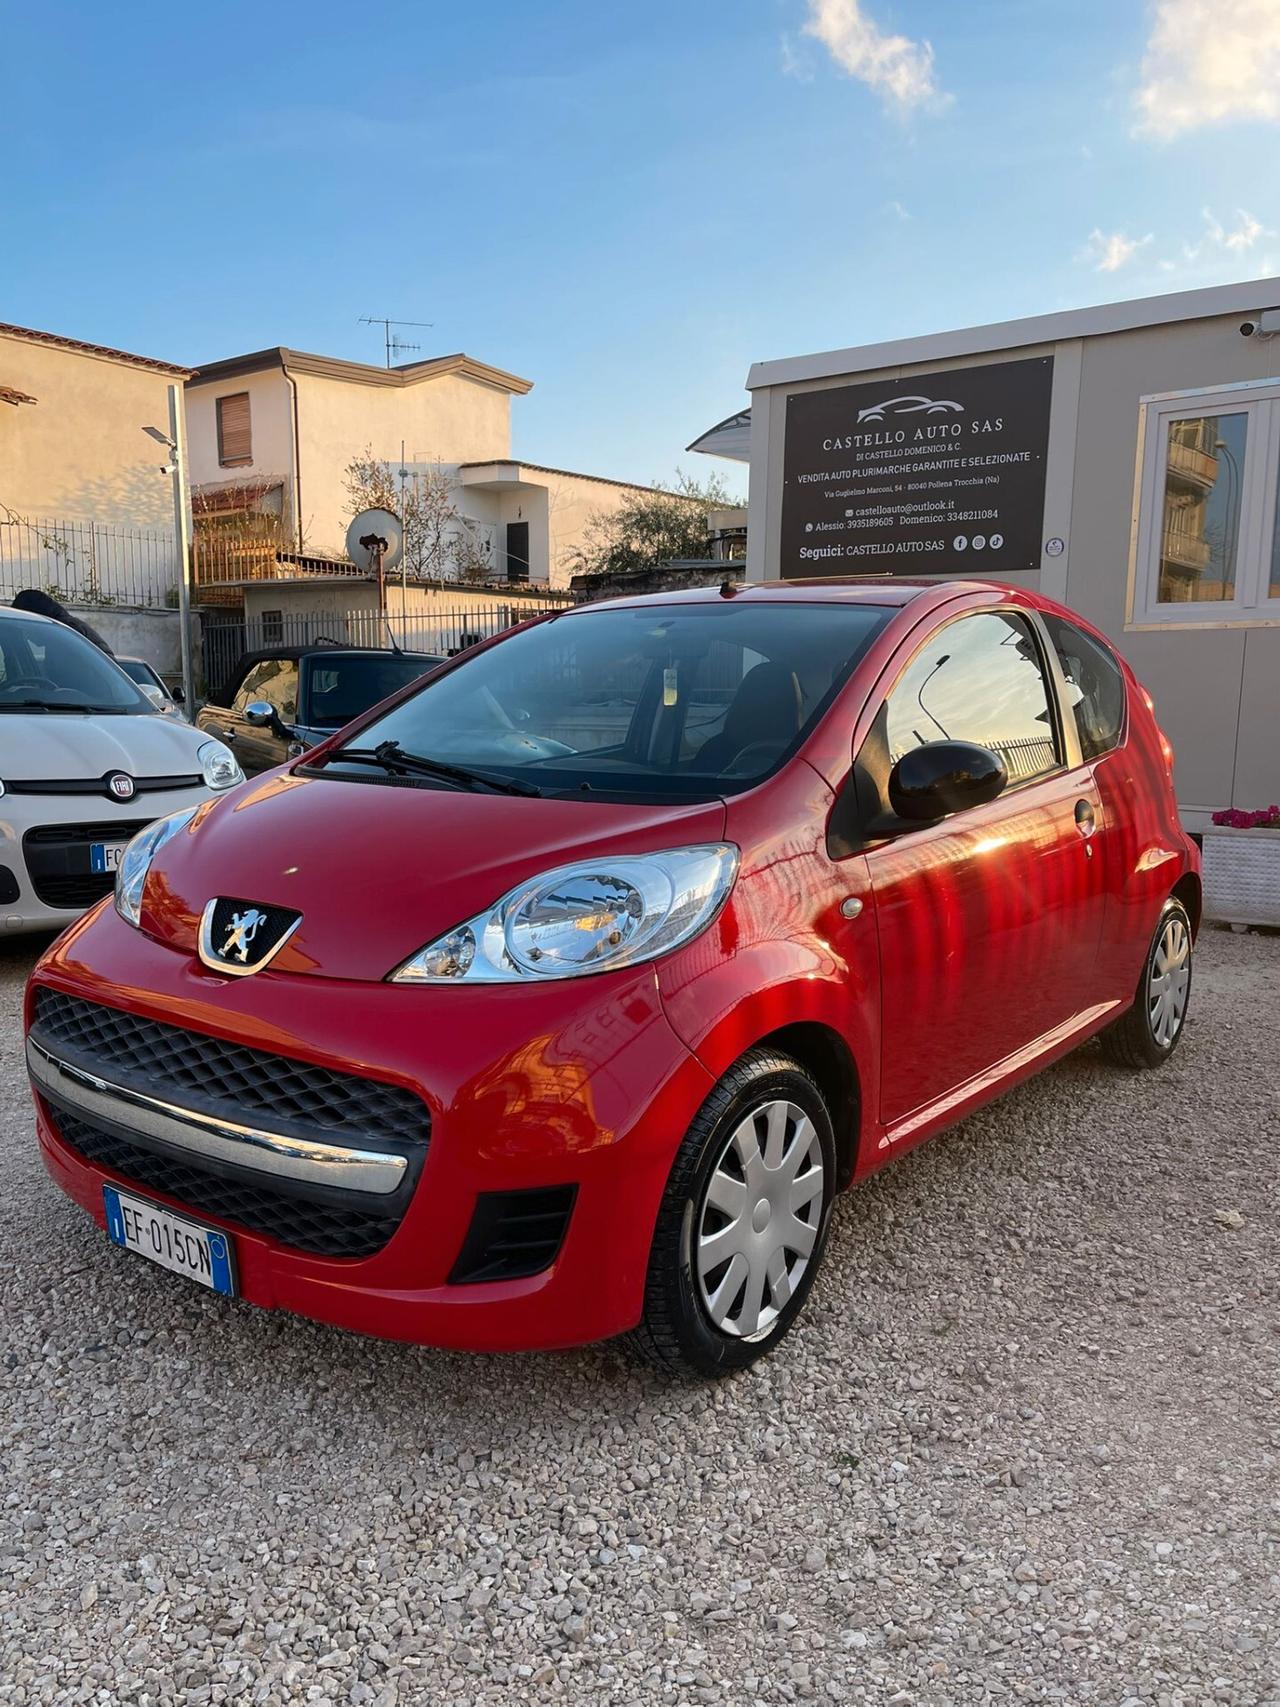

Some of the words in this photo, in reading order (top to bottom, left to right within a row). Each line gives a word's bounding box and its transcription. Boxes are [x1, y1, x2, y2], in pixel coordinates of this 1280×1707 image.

[823, 431, 905, 451] CASTELLO
[913, 423, 962, 441] AUTO
[971, 417, 1003, 434] SAS
[856, 452, 864, 462] DI
[864, 448, 904, 461] CASTELLO
[904, 443, 946, 456] DOMENICO
[947, 443, 953, 451] &
[798, 472, 830, 484] VENDITA
[830, 470, 851, 481] AUTO
[852, 463, 911, 478] PLURIMARCHE
[912, 458, 960, 472] GARANTITE
[961, 458, 967, 467] E
[968, 451, 1031, 467] SELEZIONATE
[824, 491, 835, 499] Via
[835, 488, 866, 499] Guglielmo
[908, 481, 927, 491] 80040
[928, 479, 953, 489] Pollena
[954, 477, 984, 487] Trocchia
[985, 475, 1000, 485] (Na)
[847, 517, 894, 529] 3935189605
[947, 509, 999, 521] 3348211084
[855, 500, 955, 517] castelloauto@outlook.it
[799, 543, 845, 561] Seguici:
[846, 543, 895, 556] CASTELLO
[895, 540, 924, 553] AUTO
[924, 540, 945, 552] SAS
